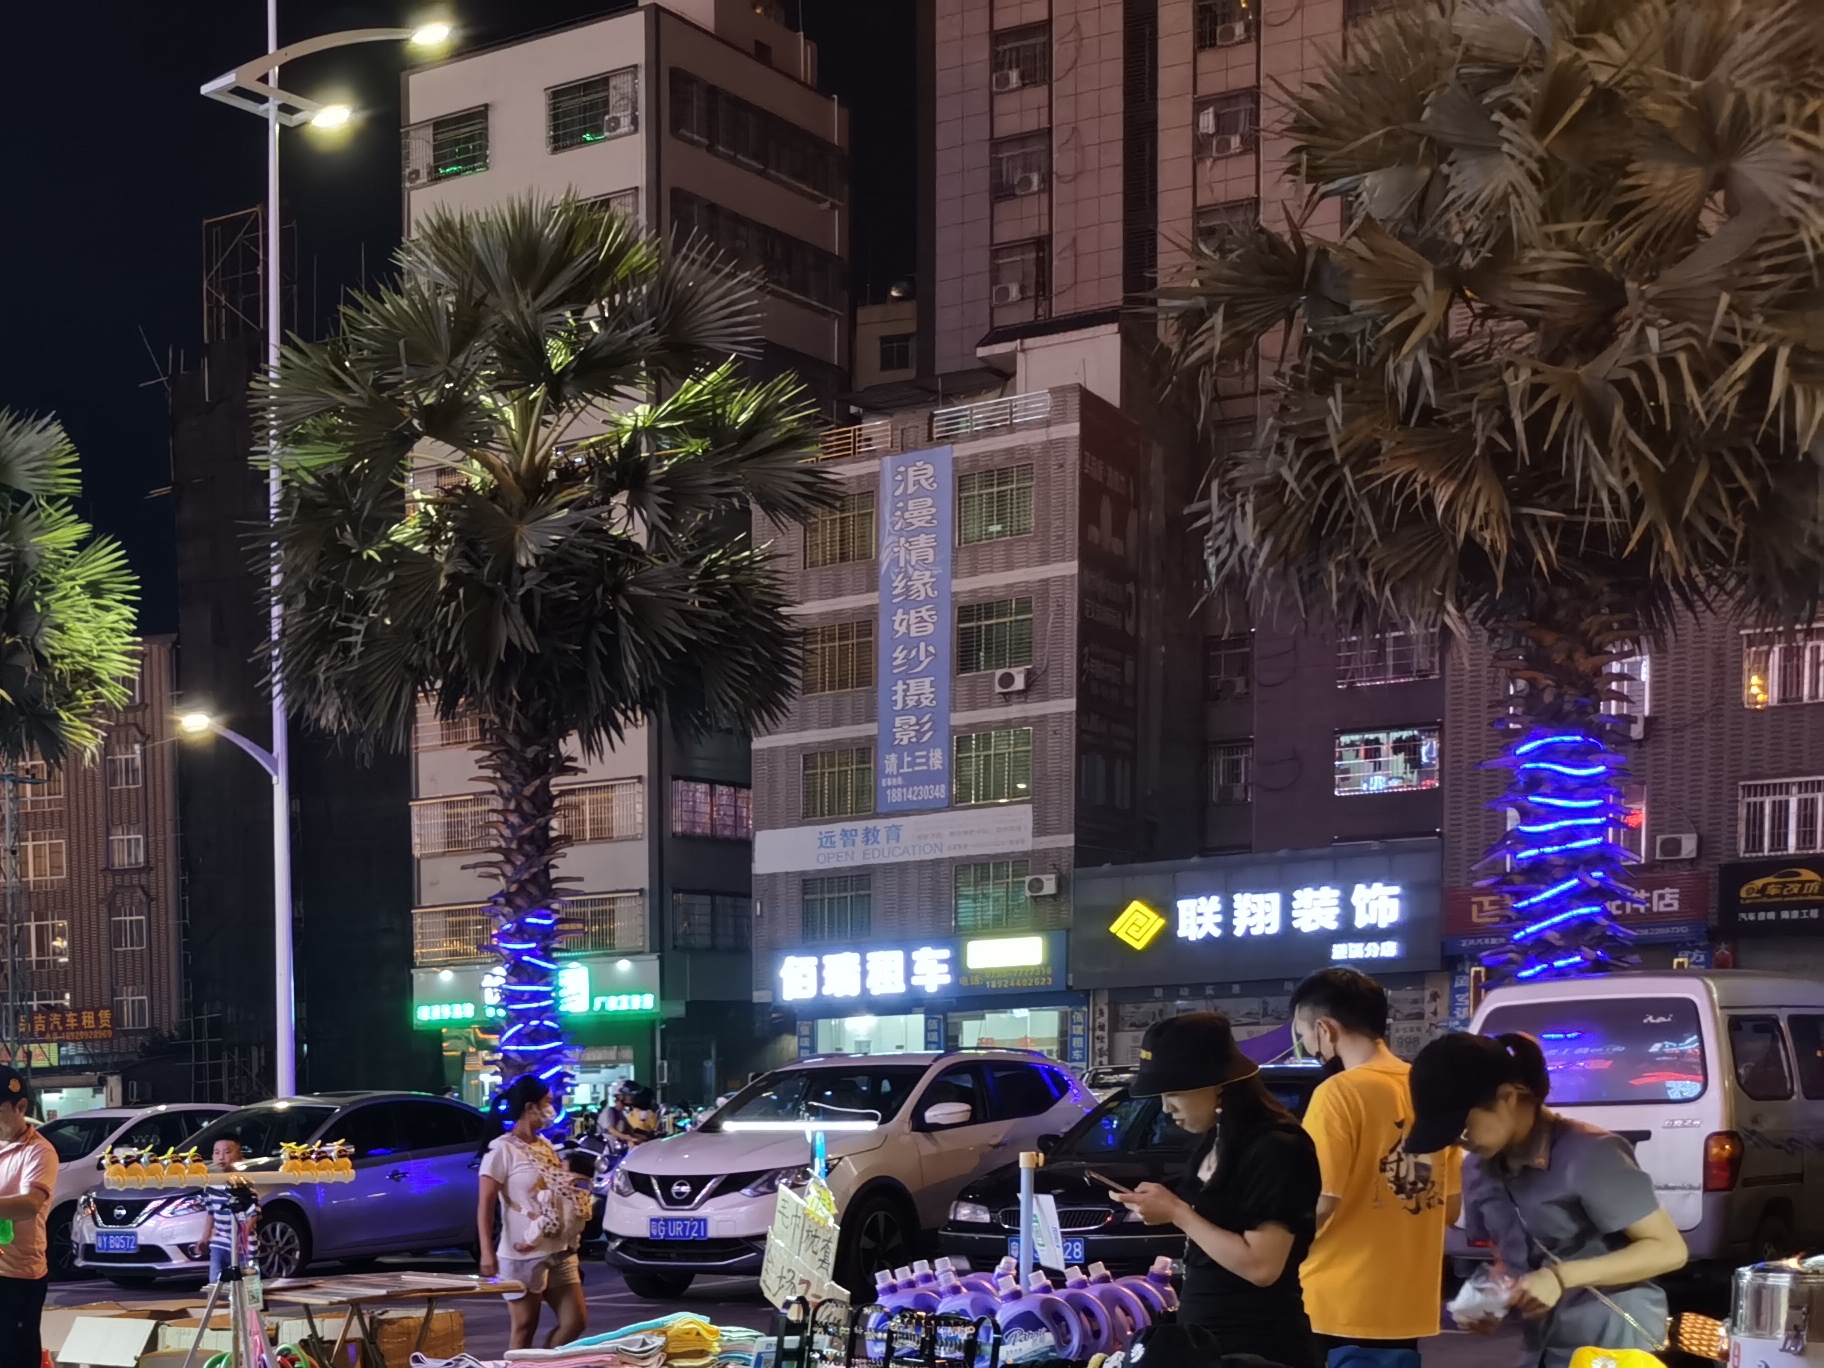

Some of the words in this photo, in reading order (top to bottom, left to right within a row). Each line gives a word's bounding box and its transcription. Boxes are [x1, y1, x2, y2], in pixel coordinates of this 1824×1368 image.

[891, 460, 938, 747] 浪漫情缘婚纱摄影
[884, 748, 943, 776] 请上三楼
[886, 784, 946, 804] 18814230348
[817, 824, 903, 850] 远智教育
[816, 851, 855, 865] OPEN
[862, 842, 944, 861] EDUCATION
[1176, 882, 1402, 941] 联翔装饰
